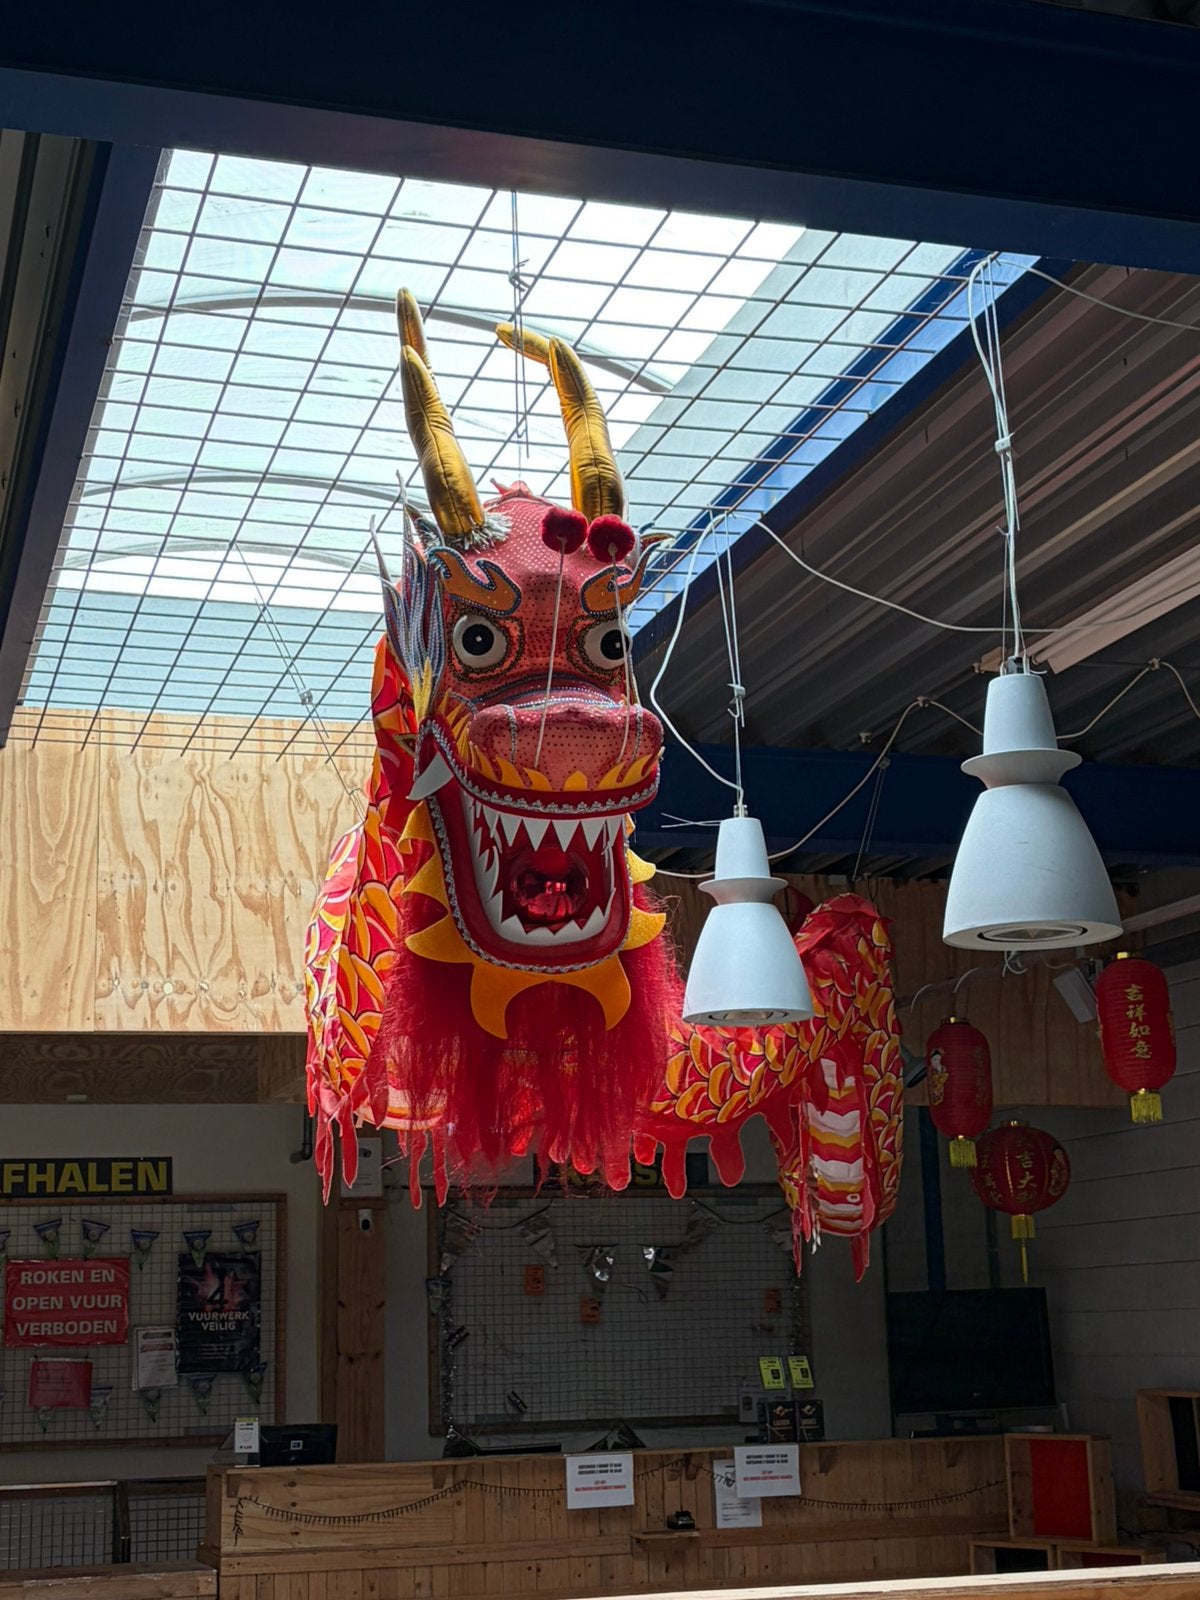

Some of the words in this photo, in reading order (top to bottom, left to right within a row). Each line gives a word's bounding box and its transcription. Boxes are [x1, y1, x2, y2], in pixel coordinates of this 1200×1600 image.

[1124, 983, 1152, 1060] 吉祥如意
[0, 1161, 168, 1195] FHALEN
[20, 1269, 85, 1285] ROKEN
[90, 1268, 115, 1283] EN
[12, 1295, 64, 1311] OPEN
[69, 1294, 122, 1309] VUUR
[187, 1310, 250, 1321] VUURWERK
[15, 1320, 118, 1337] VERBODEN
[201, 1321, 236, 1332] VEILIG
